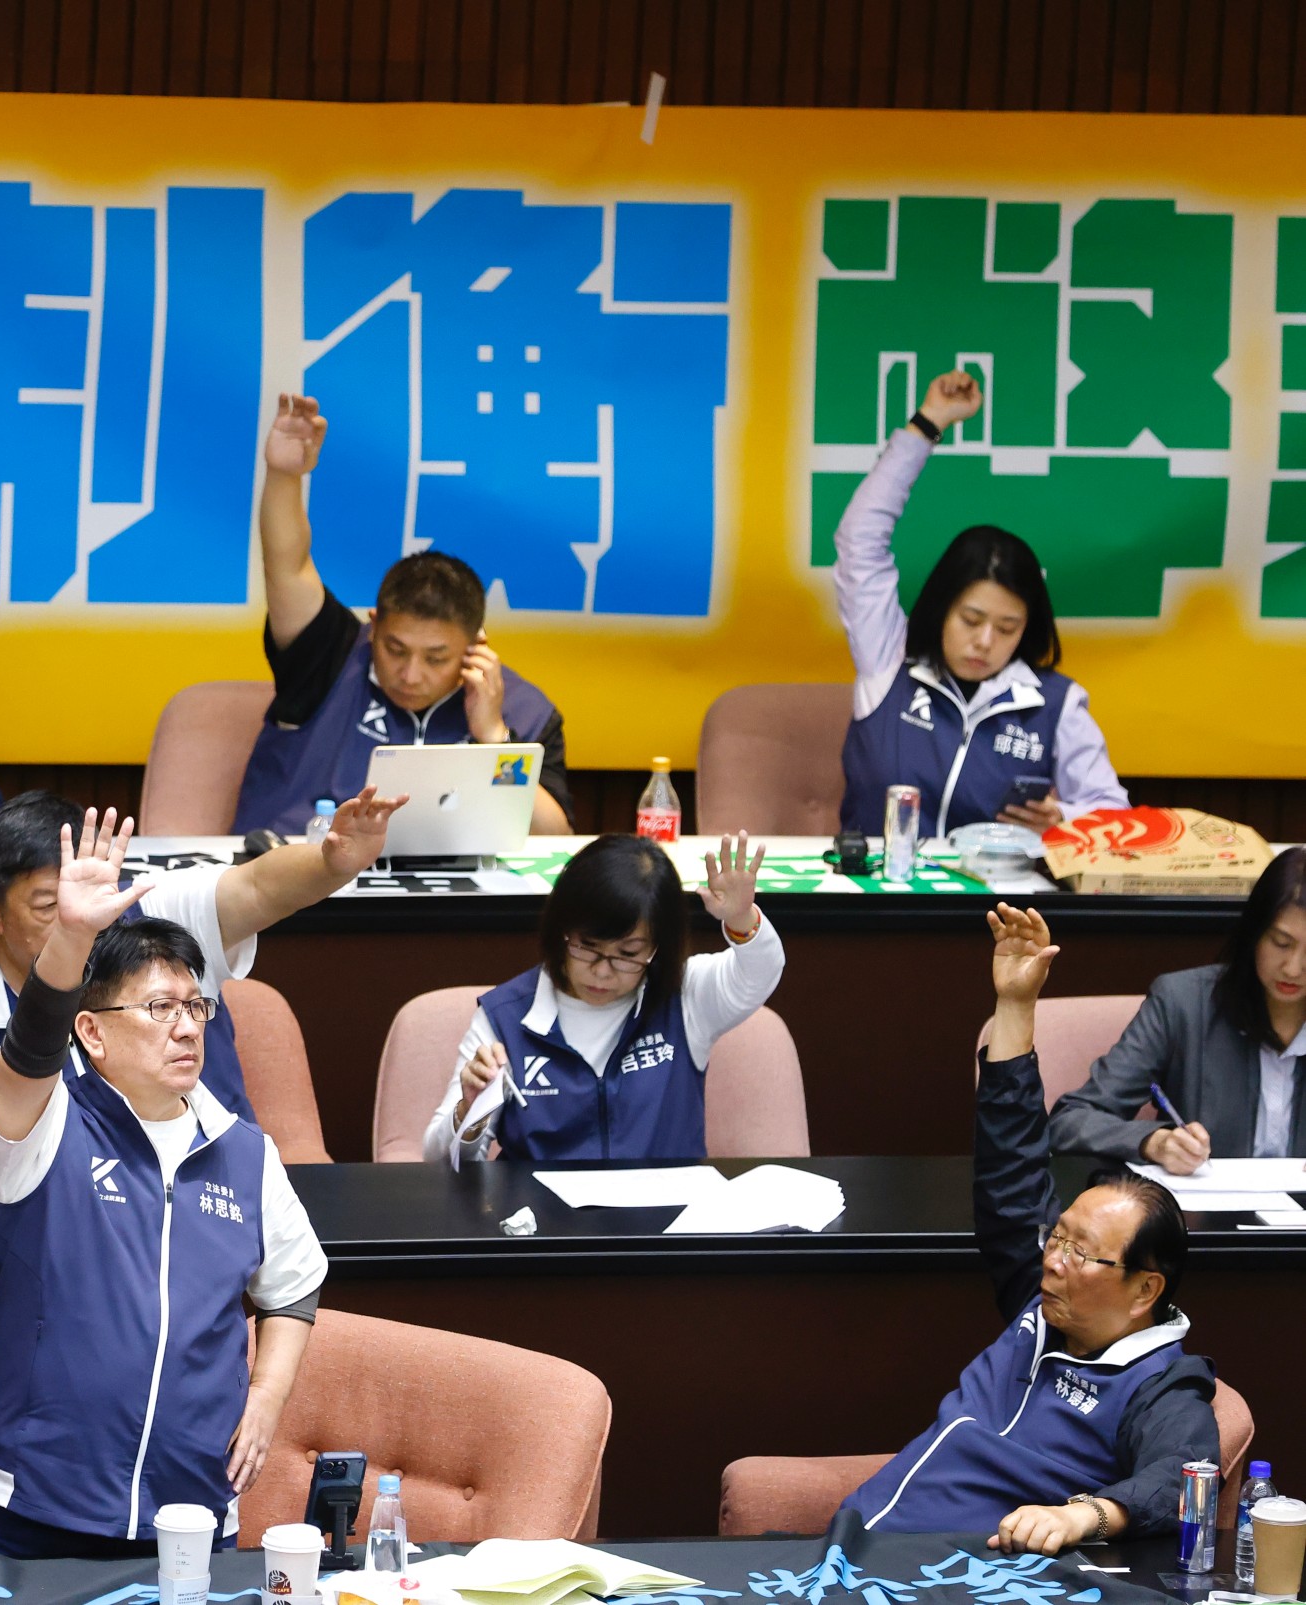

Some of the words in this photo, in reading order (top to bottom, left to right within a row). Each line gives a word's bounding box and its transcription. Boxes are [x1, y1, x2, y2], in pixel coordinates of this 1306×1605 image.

[621, 1043, 675, 1074] 呂玉玲
[205, 1182, 235, 1200] 立法委員
[200, 1193, 243, 1224] 林思銘
[1055, 1377, 1099, 1415] 林德福
[1065, 1369, 1098, 1395] 立法委員
